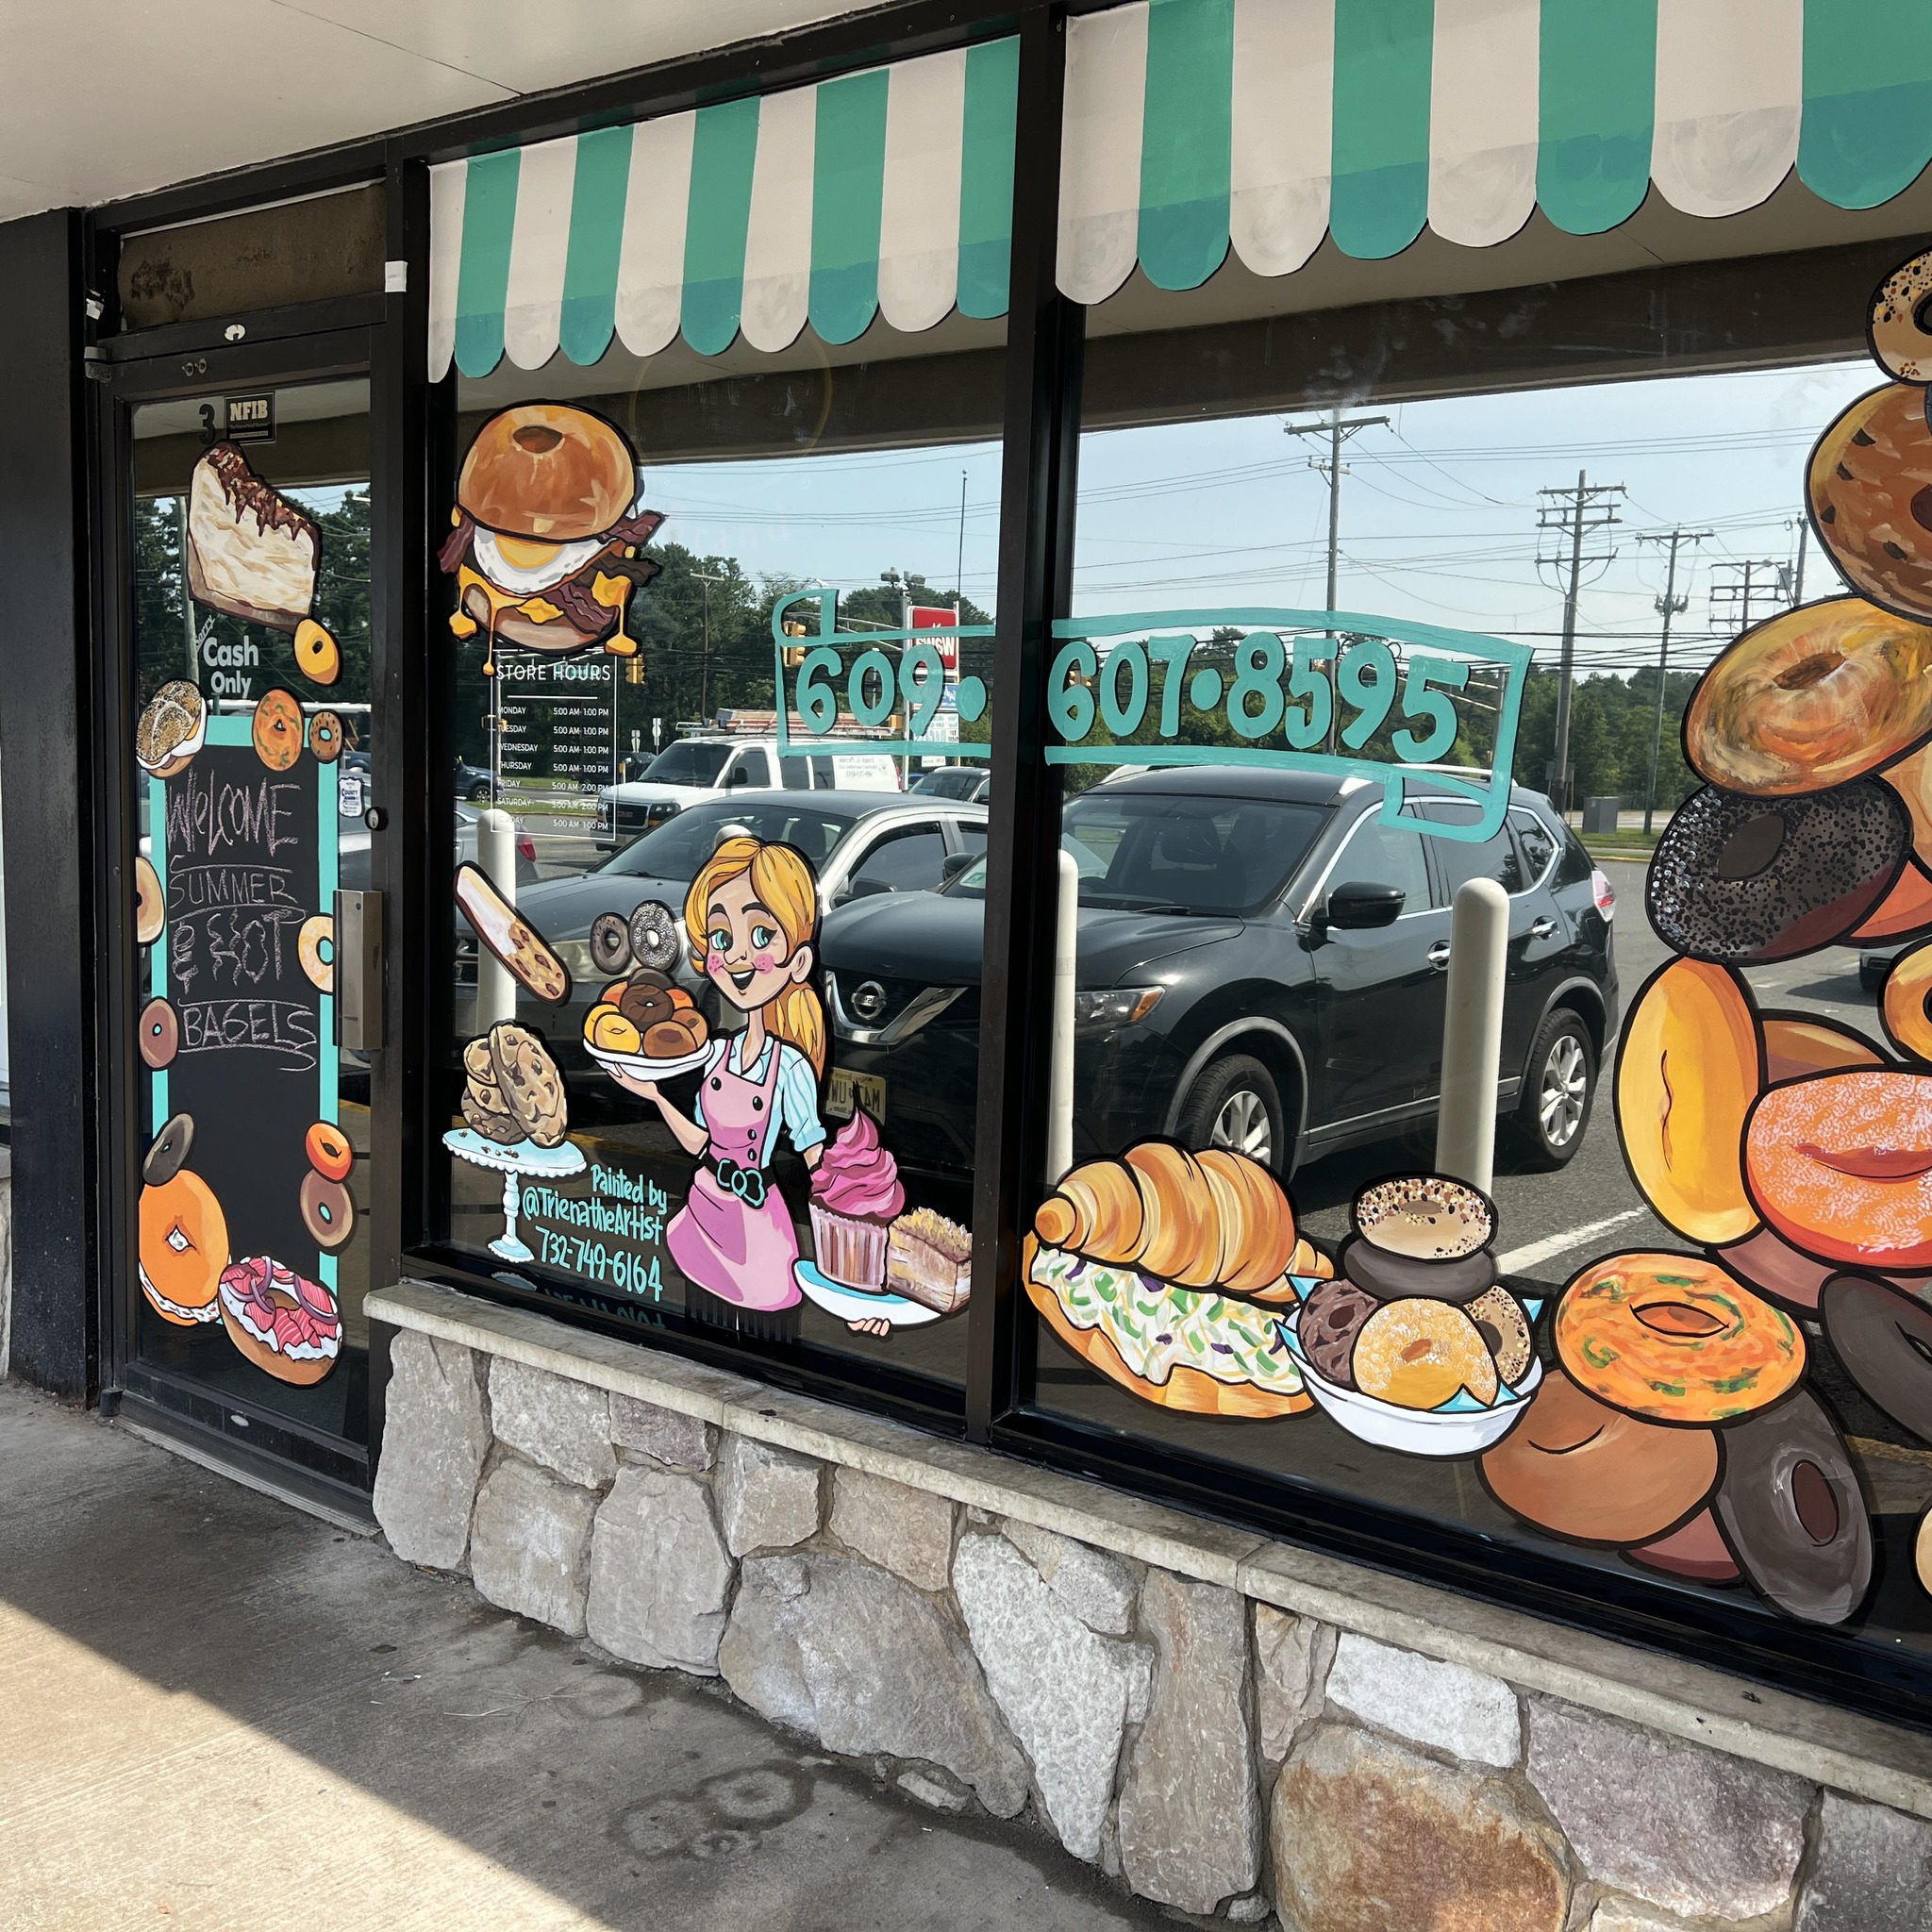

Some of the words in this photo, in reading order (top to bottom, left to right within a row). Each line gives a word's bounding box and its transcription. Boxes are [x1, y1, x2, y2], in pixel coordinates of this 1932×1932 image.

[230, 400, 268, 421] NFIB
[198, 403, 216, 445] 3
[203, 635, 259, 667] Cash
[210, 670, 252, 700] Only
[496, 664, 547, 681] STORE
[553, 664, 611, 681] HOURS
[583, 708, 597, 716] 1:00
[598, 708, 609, 716] PM
[598, 727, 609, 736] PM
[583, 745, 597, 754] 1:00
[598, 746, 609, 755] PM
[553, 763, 568, 772] 5:00
[597, 765, 609, 774] PM
[552, 782, 567, 791] 5:00
[497, 797, 532, 807] SATURDAY
[597, 804, 609, 812] PM
[597, 822, 609, 830] PM
[169, 868, 298, 909] SUMMER
[206, 908, 293, 988] HOT
[181, 1003, 317, 1050] BAGELS
[591, 1163, 643, 1204] Painted
[648, 1179, 667, 1215] by
[522, 1186, 664, 1245] @TrienatheArtist
[535, 1225, 664, 1302] 732-749-6164
